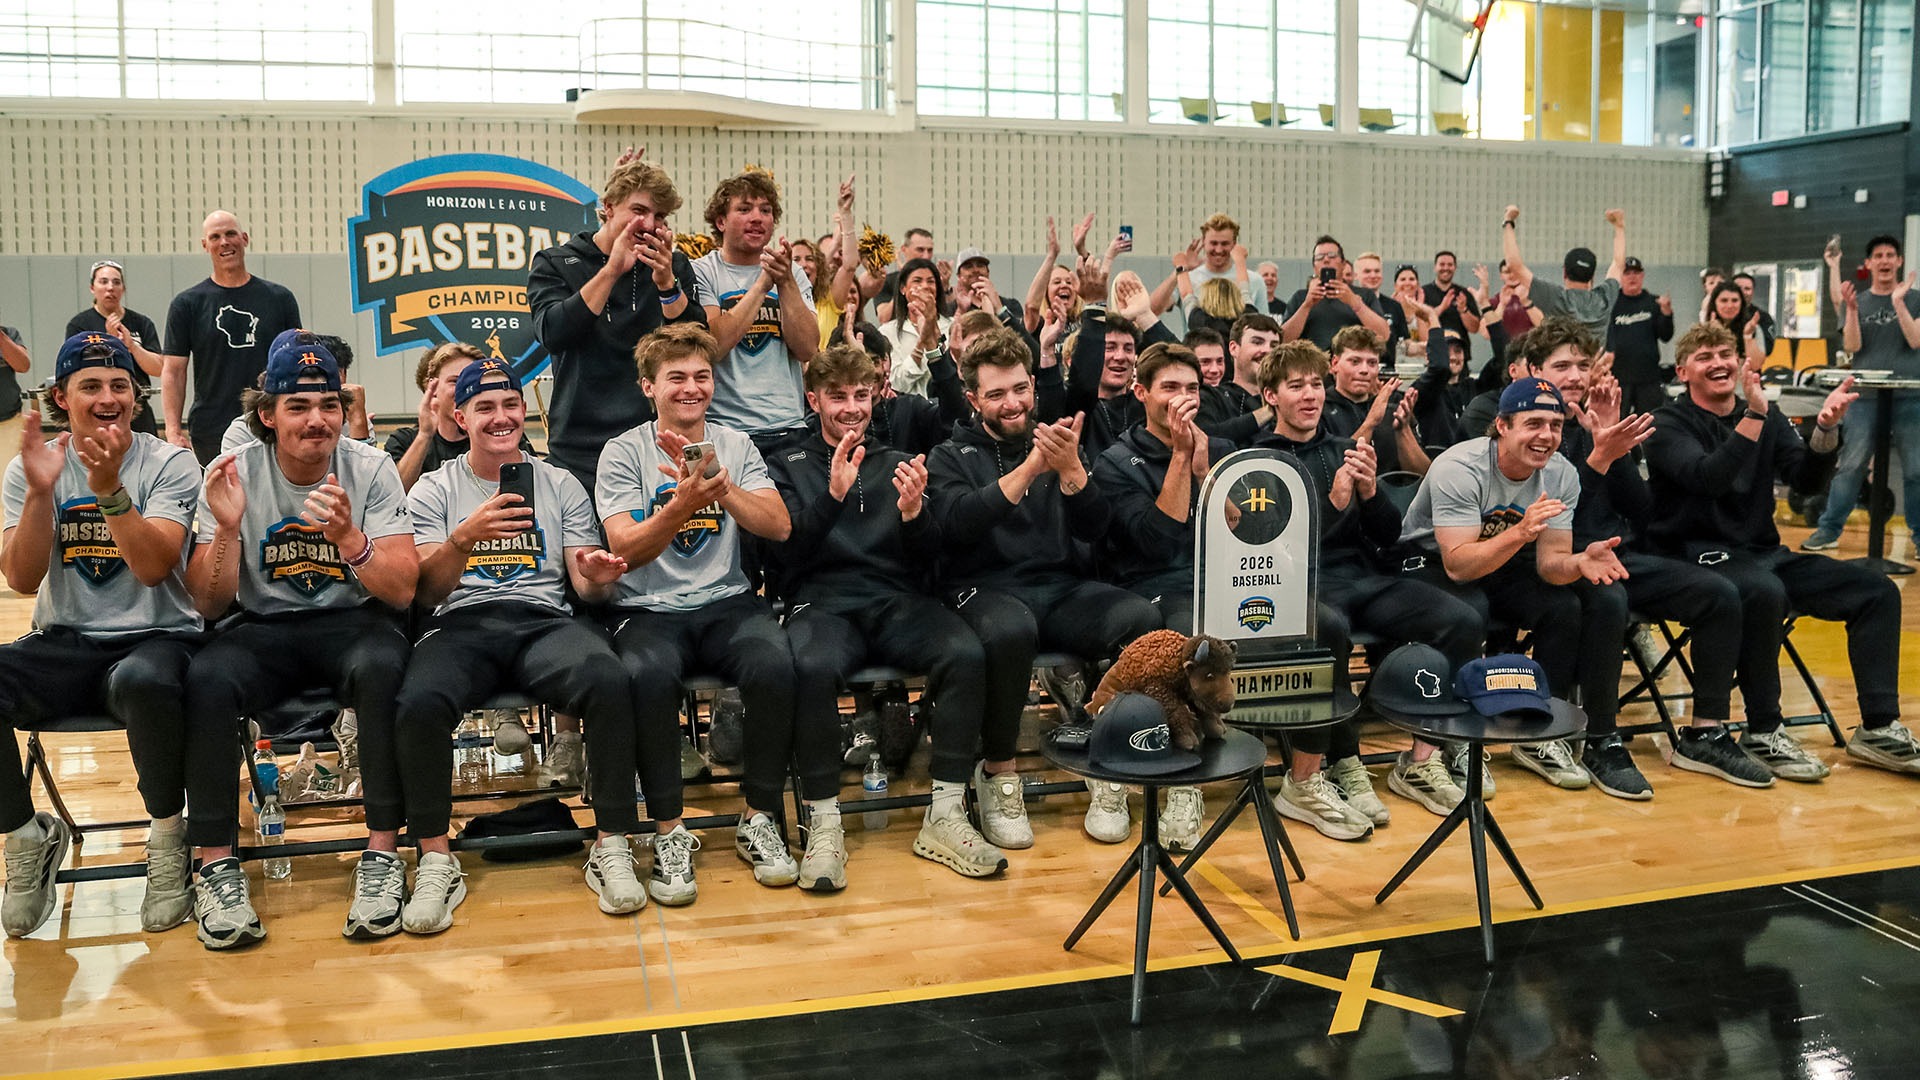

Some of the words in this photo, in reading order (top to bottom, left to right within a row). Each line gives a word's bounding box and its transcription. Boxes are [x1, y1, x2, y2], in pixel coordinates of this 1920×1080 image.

[427, 196, 486, 209] HORIZON
[489, 198, 547, 212] LEAGUE
[363, 222, 571, 284] BASEBA
[428, 290, 529, 309] CHAMPIO
[471, 317, 520, 329] 2026
[61, 522, 111, 542] BASEB
[472, 533, 541, 551] ASEBALL
[265, 540, 340, 563] BASEBAL
[287, 563, 330, 574] CHAMPIONS
[1240, 556, 1273, 570] 2026
[1232, 574, 1282, 588] BASEBALL
[1240, 606, 1273, 617] BASEBALL
[1231, 671, 1313, 694] HAMPION
